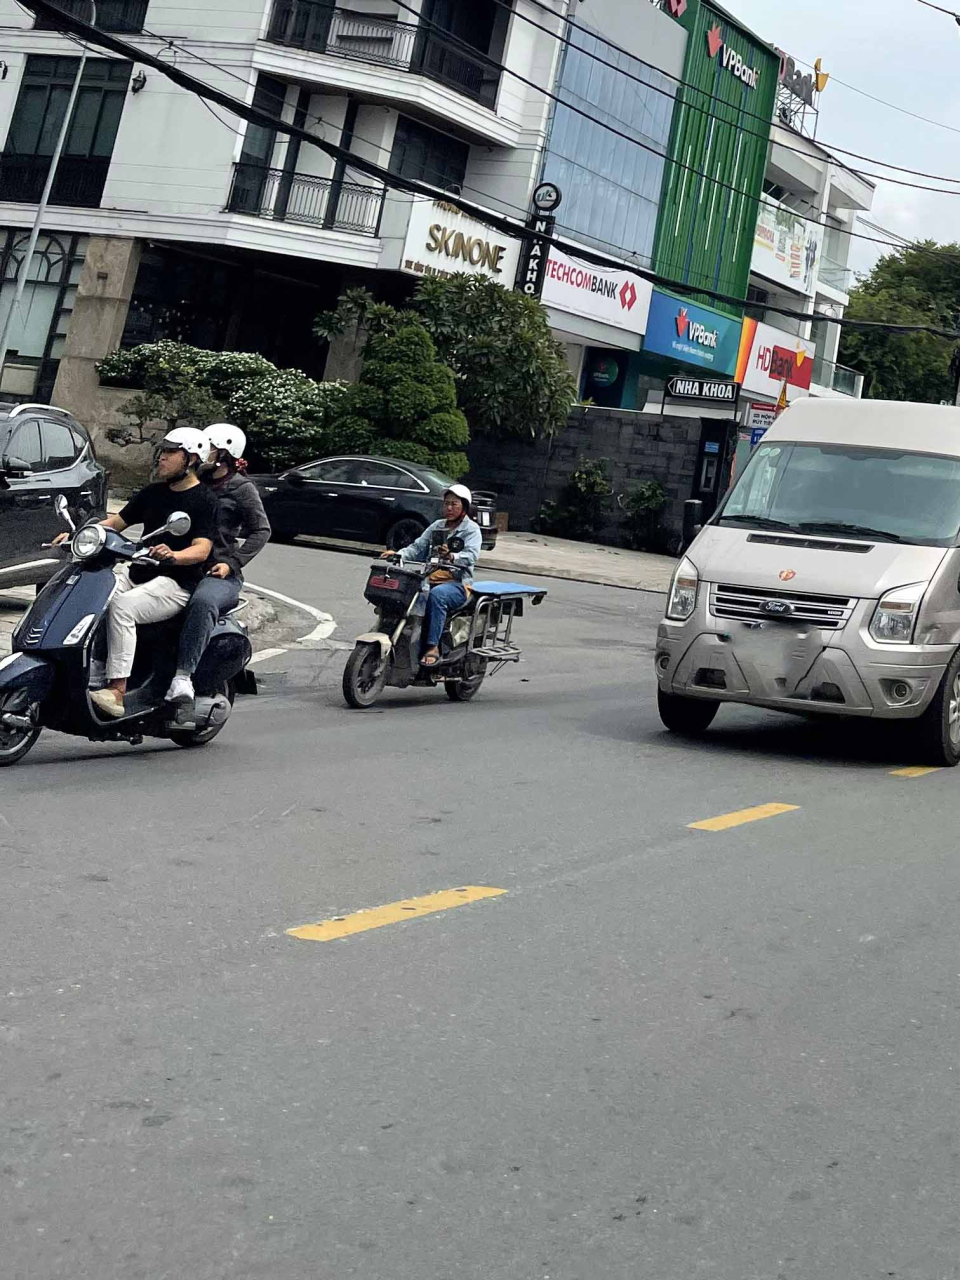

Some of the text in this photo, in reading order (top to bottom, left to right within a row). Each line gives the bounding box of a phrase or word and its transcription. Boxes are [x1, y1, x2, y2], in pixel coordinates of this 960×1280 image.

[722, 43, 757, 90] VPBank
[546, 259, 618, 300] TECHCOMBANK
[689, 321, 717, 349] VPBank
[756, 345, 793, 380] HDBank
[676, 380, 733, 399] NHA KHOA
[765, 601, 785, 612] Ford
